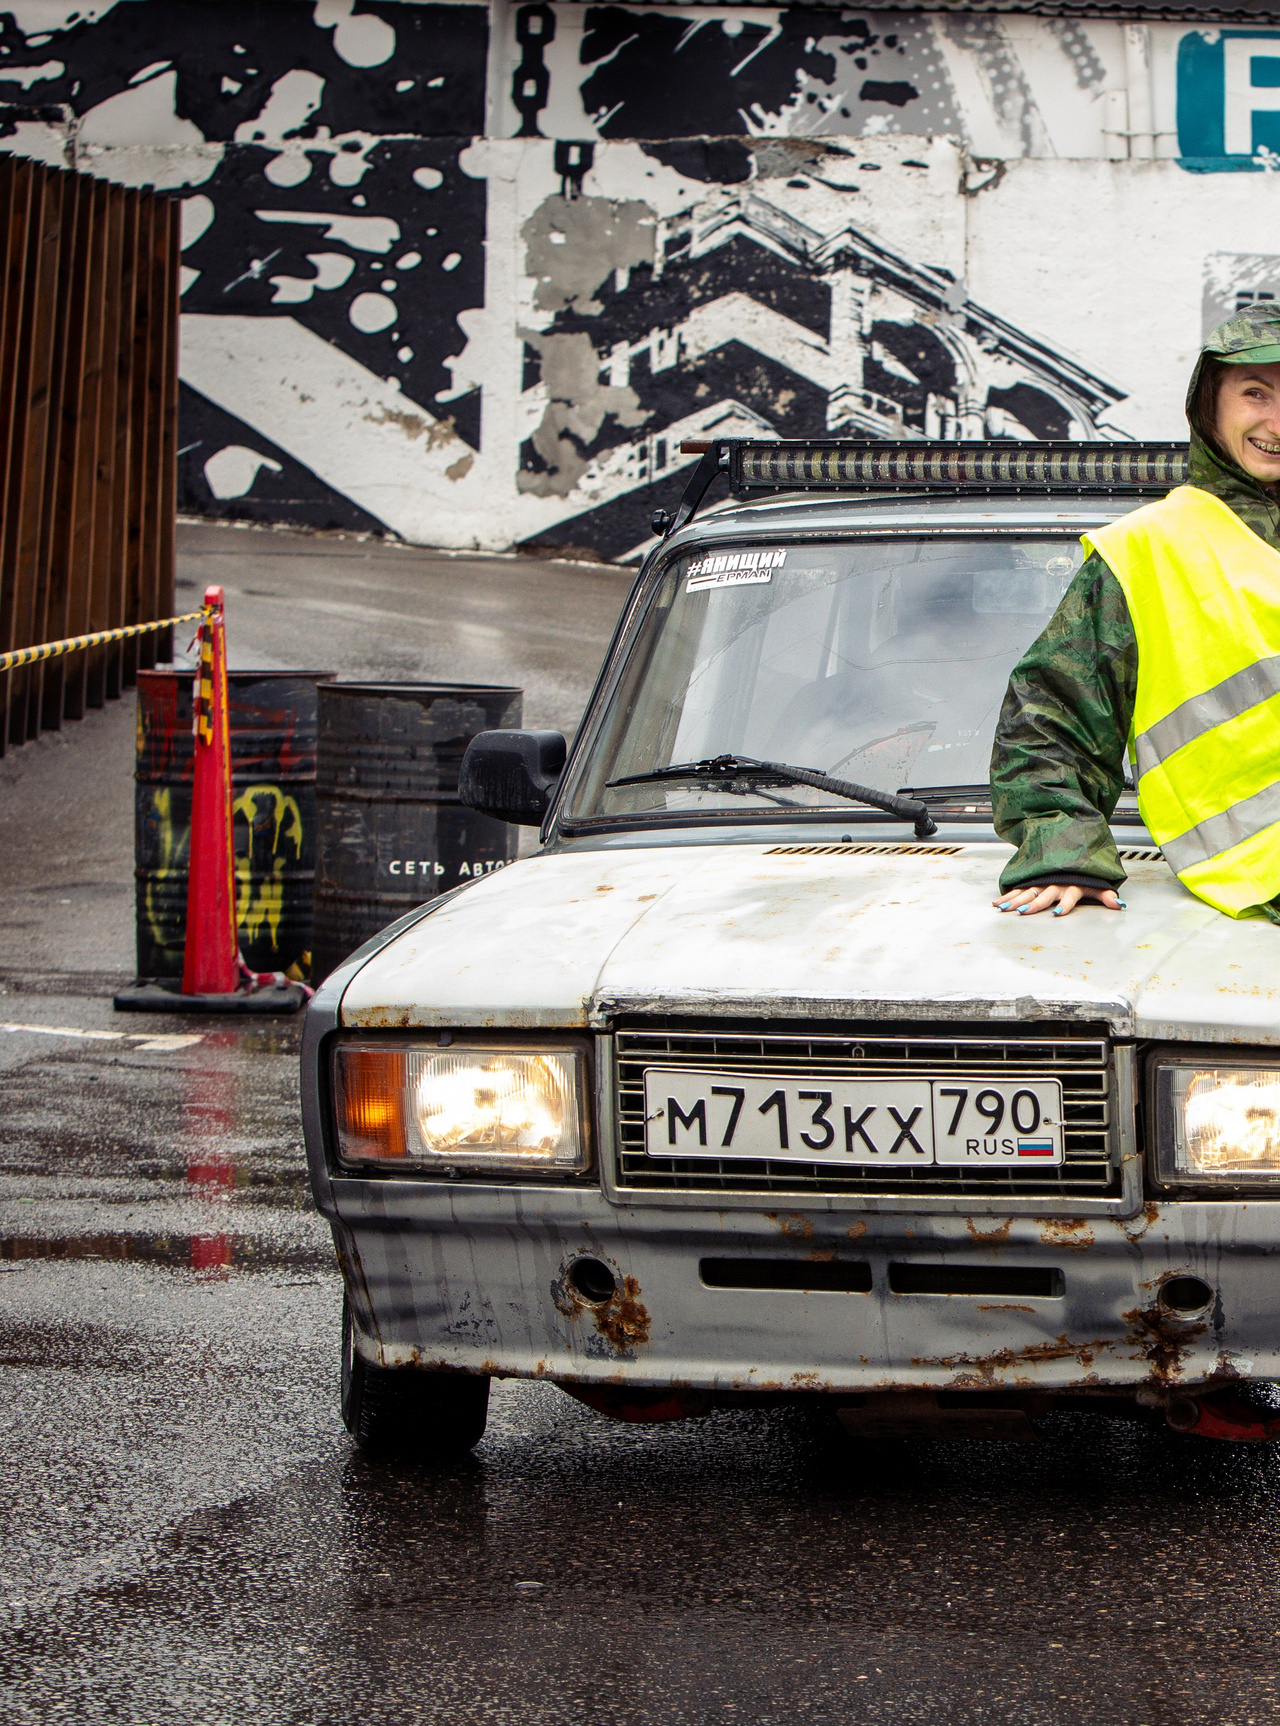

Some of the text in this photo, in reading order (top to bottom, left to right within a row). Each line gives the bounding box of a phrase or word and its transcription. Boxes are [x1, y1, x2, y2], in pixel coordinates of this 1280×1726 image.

[687, 549, 787, 577] #ЯНИЩИЙ
[389, 858, 517, 877] СЕТЬ АВТО
[939, 1088, 1041, 1136] 790
[966, 1138, 1015, 1156] RUS
